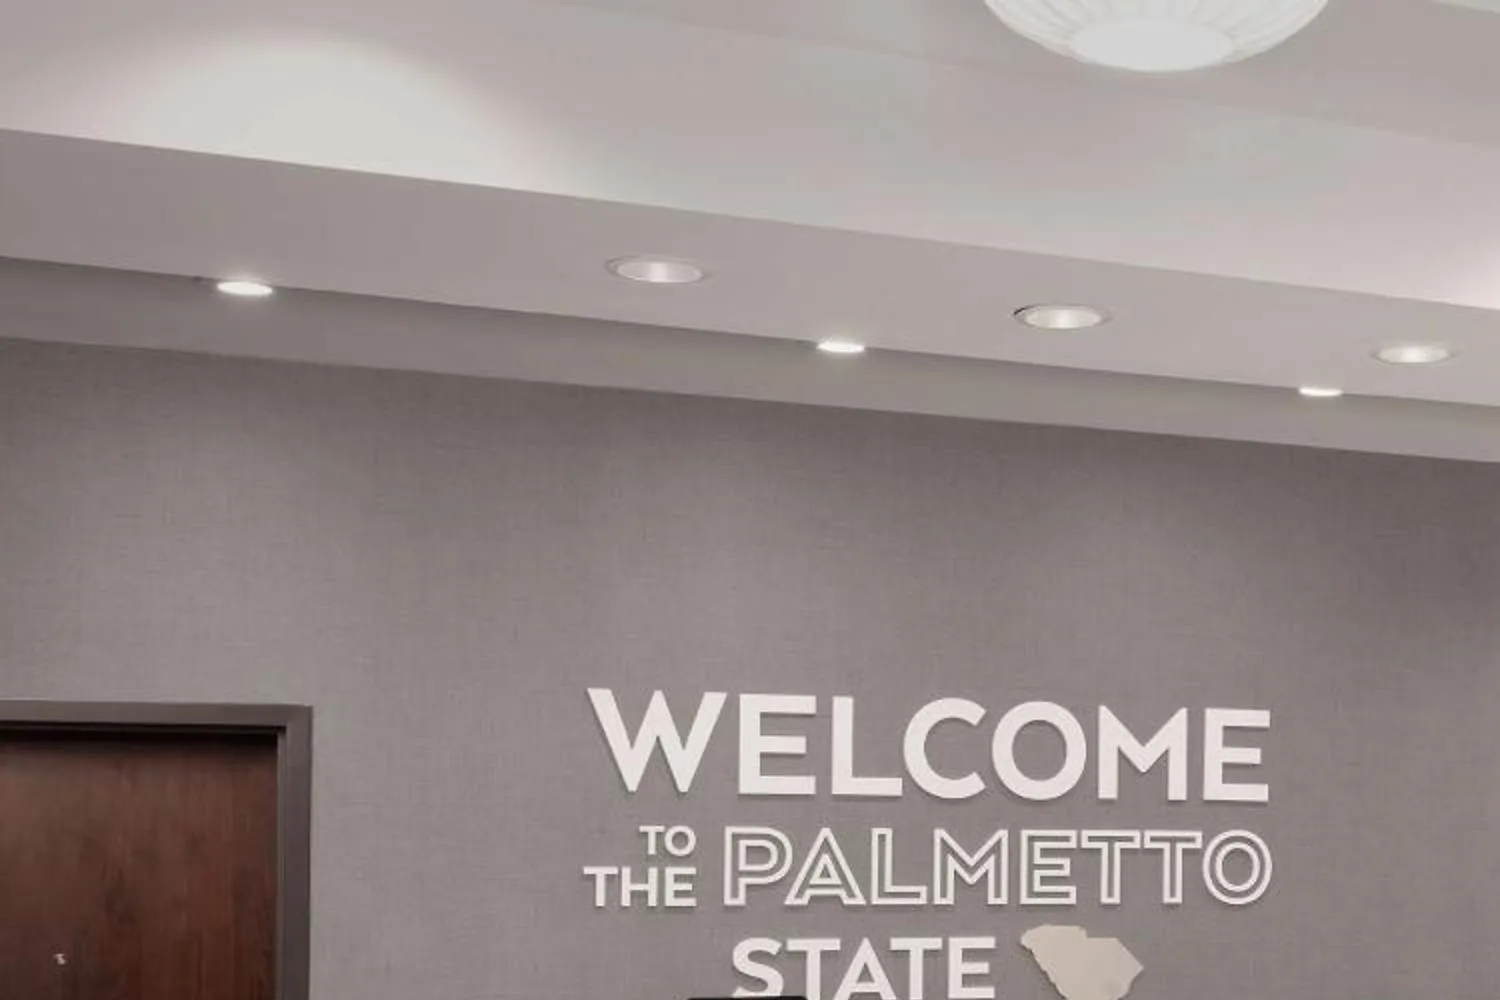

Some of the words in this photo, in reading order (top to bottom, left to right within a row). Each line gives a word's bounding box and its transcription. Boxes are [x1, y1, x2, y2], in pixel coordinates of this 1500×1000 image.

[587, 687, 1272, 803] WELCOME
[638, 825, 697, 857] TO
[723, 825, 1274, 907] PALMETTO
[582, 865, 697, 908] THE
